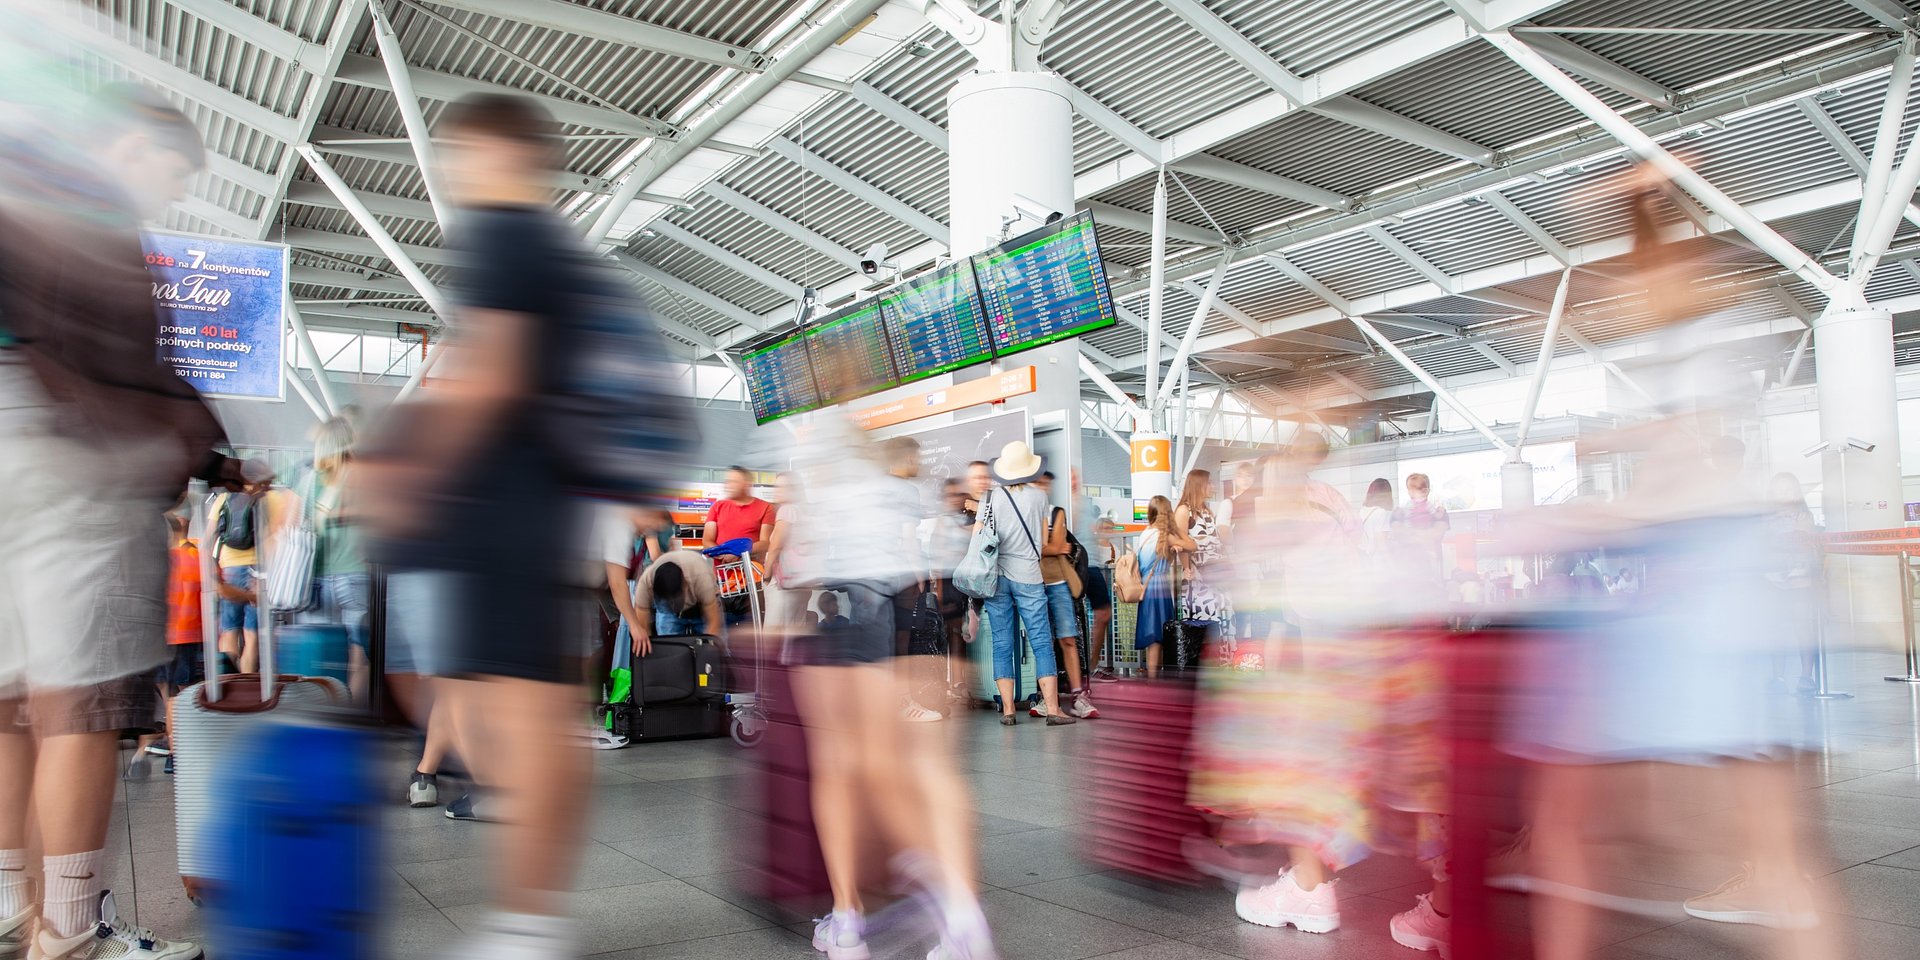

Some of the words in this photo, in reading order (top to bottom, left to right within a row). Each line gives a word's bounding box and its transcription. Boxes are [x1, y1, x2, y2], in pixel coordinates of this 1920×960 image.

[144, 250, 175, 266] óże
[187, 249, 206, 269] 7
[202, 260, 271, 277] kontynentów
[177, 274, 232, 307] Tour
[160, 325, 196, 334] ponad
[199, 325, 217, 336] 40
[220, 326, 238, 338] lat
[155, 336, 203, 348] spólnych
[206, 341, 252, 353] podróży
[163, 355, 238, 368] www.logostour.pl
[174, 368, 190, 376] 801
[1141, 445, 1158, 468] C
[1533, 465, 1556, 474] OWA
[1841, 531, 1901, 540] WARSZAWIE
